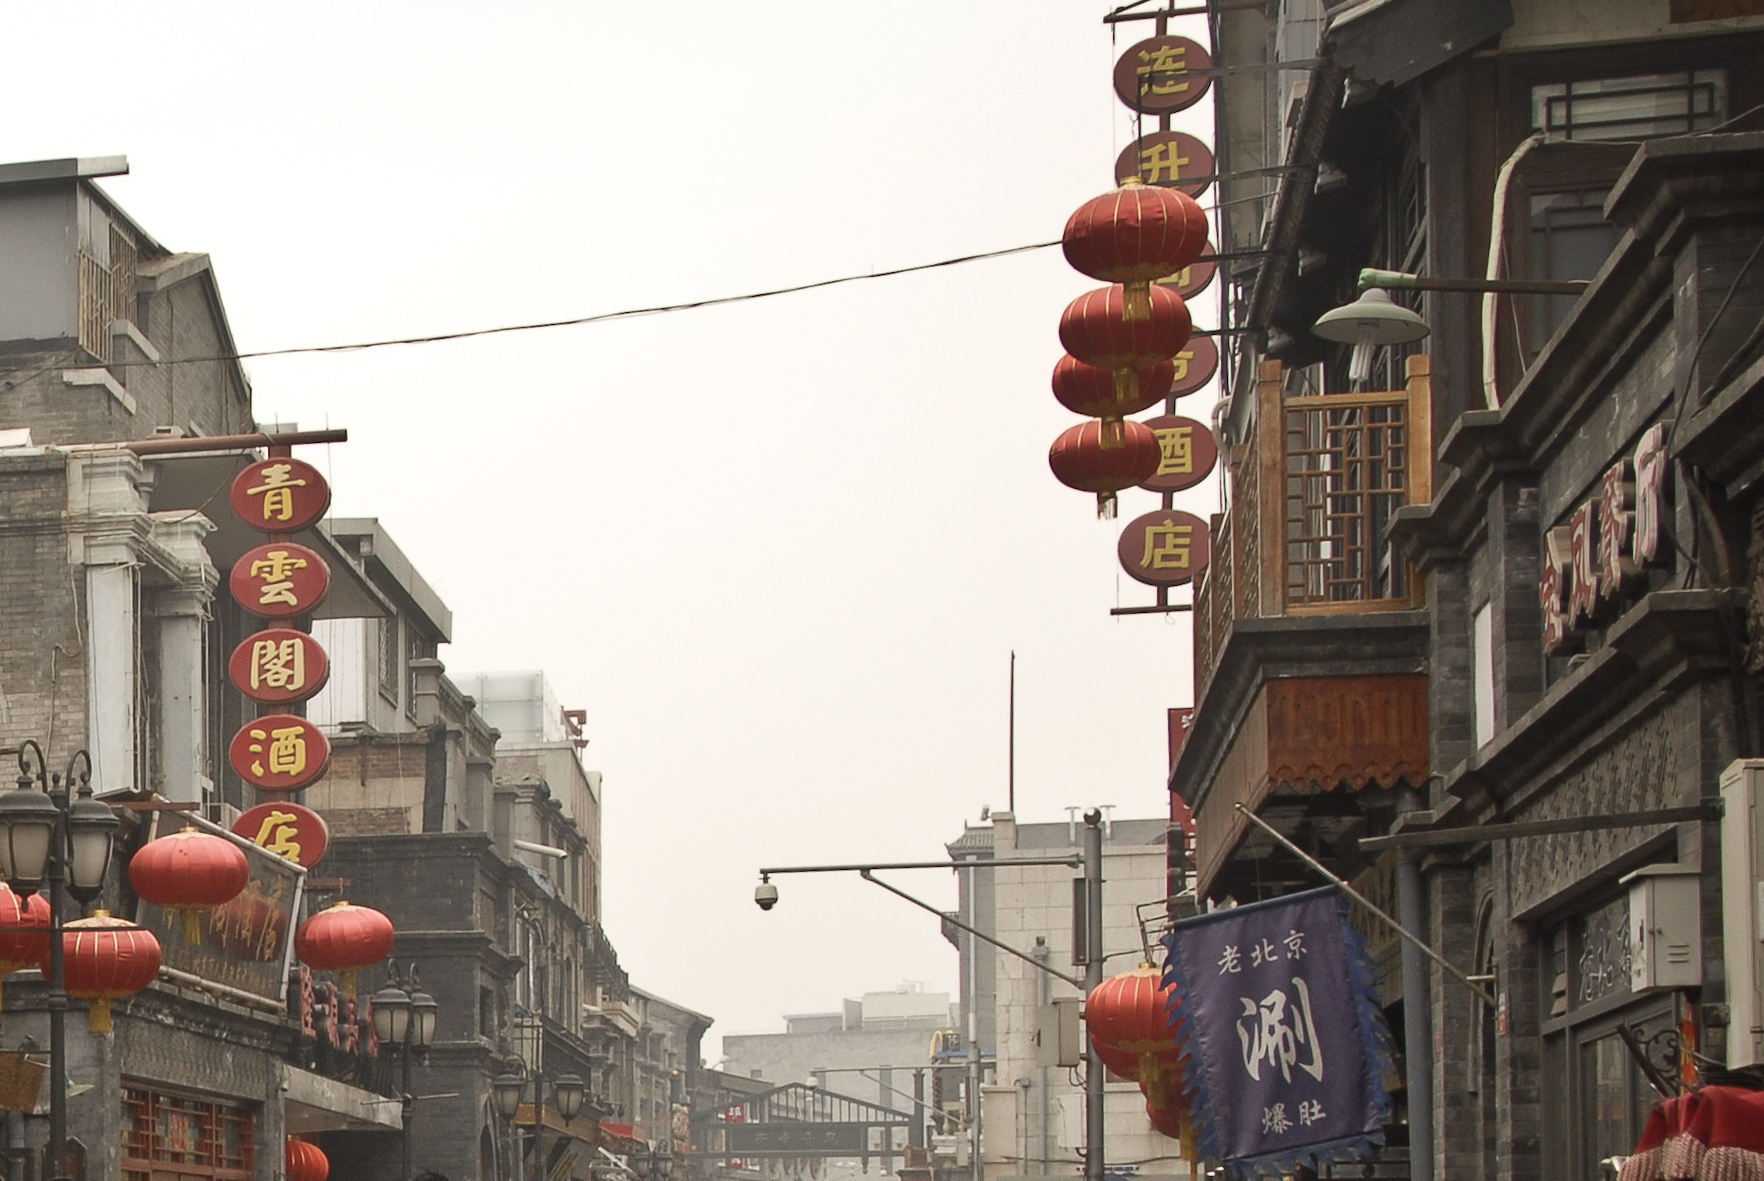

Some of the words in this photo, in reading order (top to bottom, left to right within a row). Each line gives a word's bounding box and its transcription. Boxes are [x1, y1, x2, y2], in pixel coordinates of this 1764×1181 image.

[1136, 45, 1194, 570] 连升酒店
[246, 463, 307, 867] 青雲閣酒店
[1218, 930, 1307, 975] 老北京
[1236, 977, 1323, 1084] 涮
[1262, 1099, 1326, 1134] 爆肚
